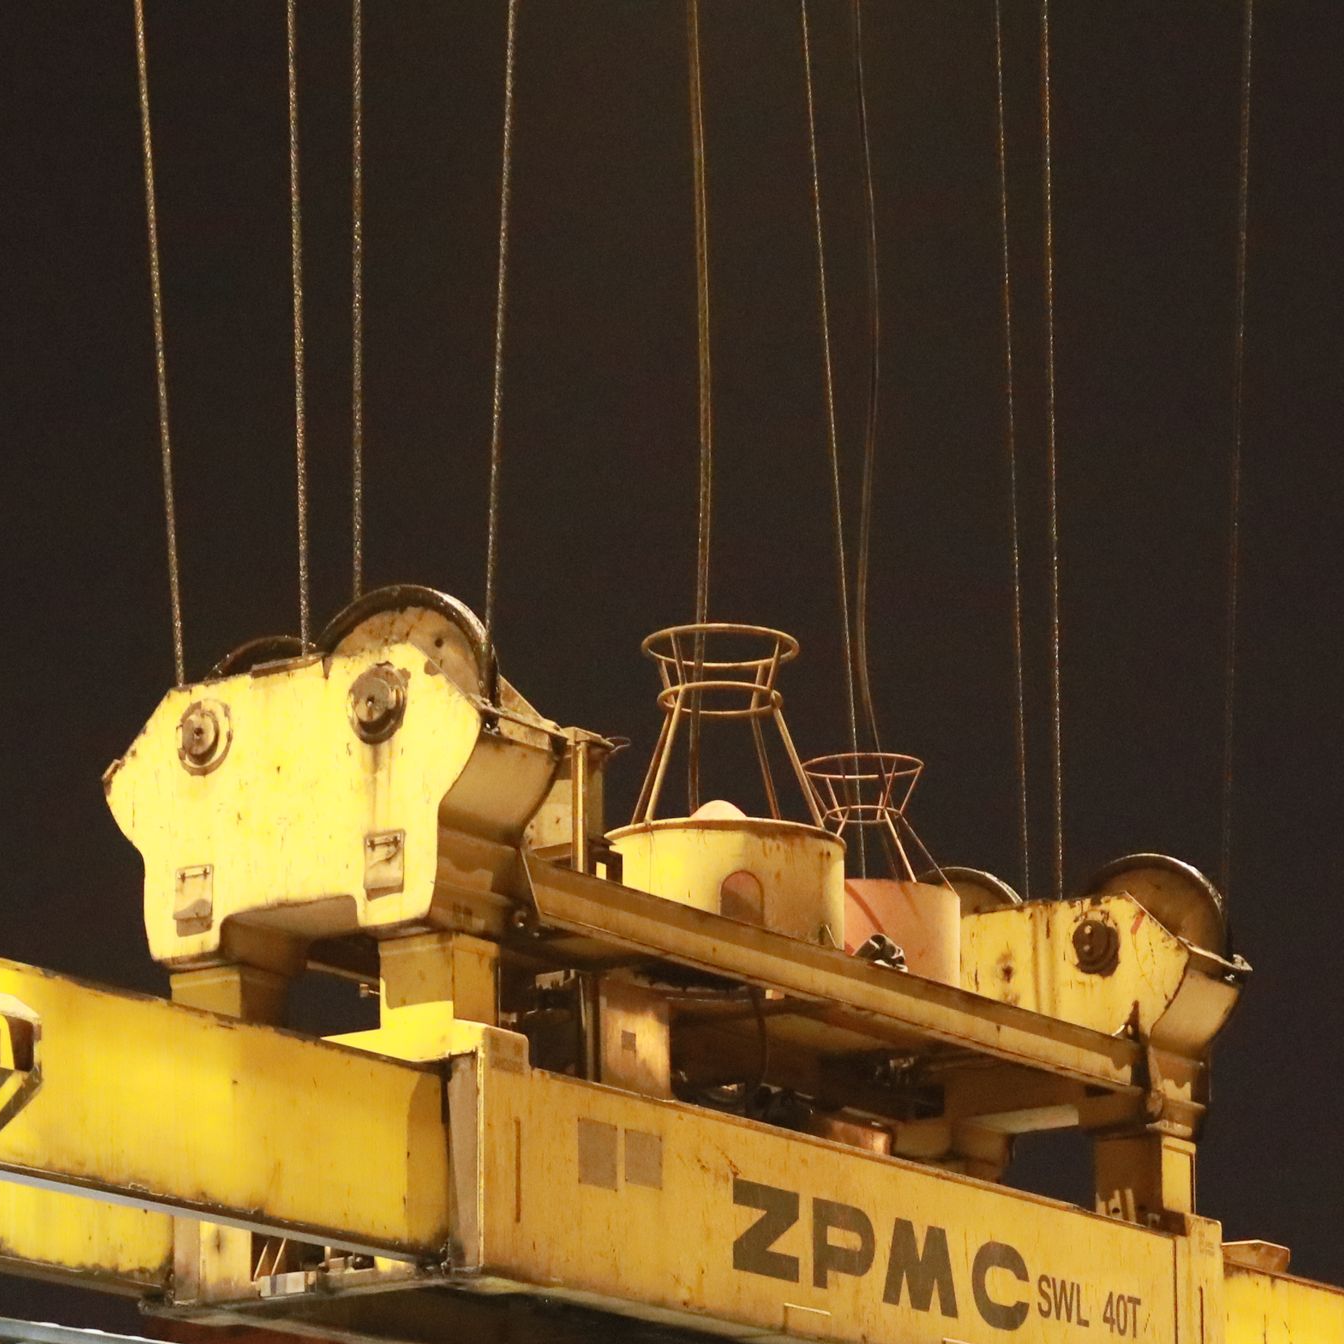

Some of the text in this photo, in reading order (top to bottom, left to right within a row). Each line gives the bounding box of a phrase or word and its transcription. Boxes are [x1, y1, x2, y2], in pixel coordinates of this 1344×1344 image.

[732, 1178, 1142, 1339] ZPMC SWL 40T
